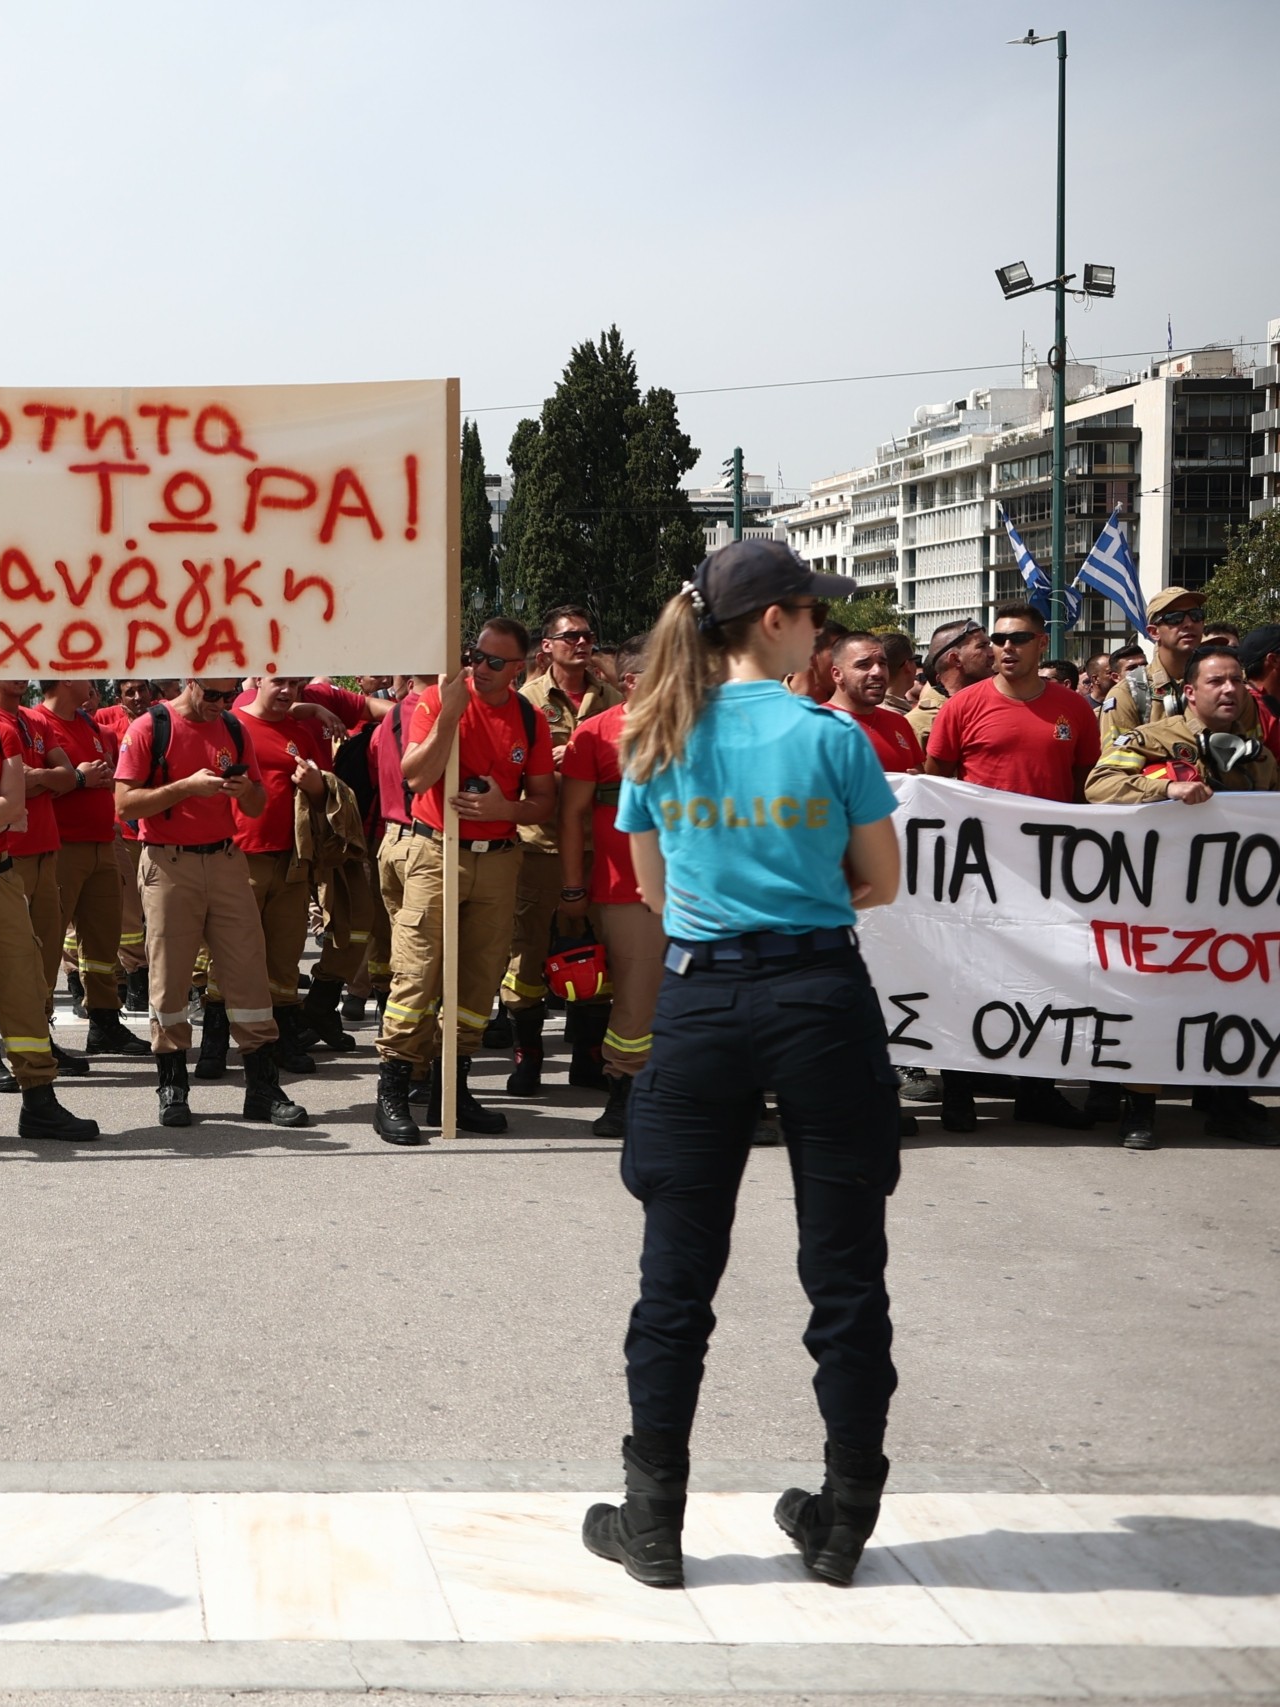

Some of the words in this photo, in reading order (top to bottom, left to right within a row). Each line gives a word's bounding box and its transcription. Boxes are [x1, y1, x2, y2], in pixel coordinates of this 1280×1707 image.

[69, 454, 420, 545] ΤΩΡΑ!
[659, 796, 831, 831] POLICE
[906, 818, 997, 904] ΓΙΑ
[1020, 823, 1160, 908] ΤΟΝ
[1186, 831, 1280, 908] ΠΟ
[972, 1001, 1133, 1070] ΟΥΤΕ
